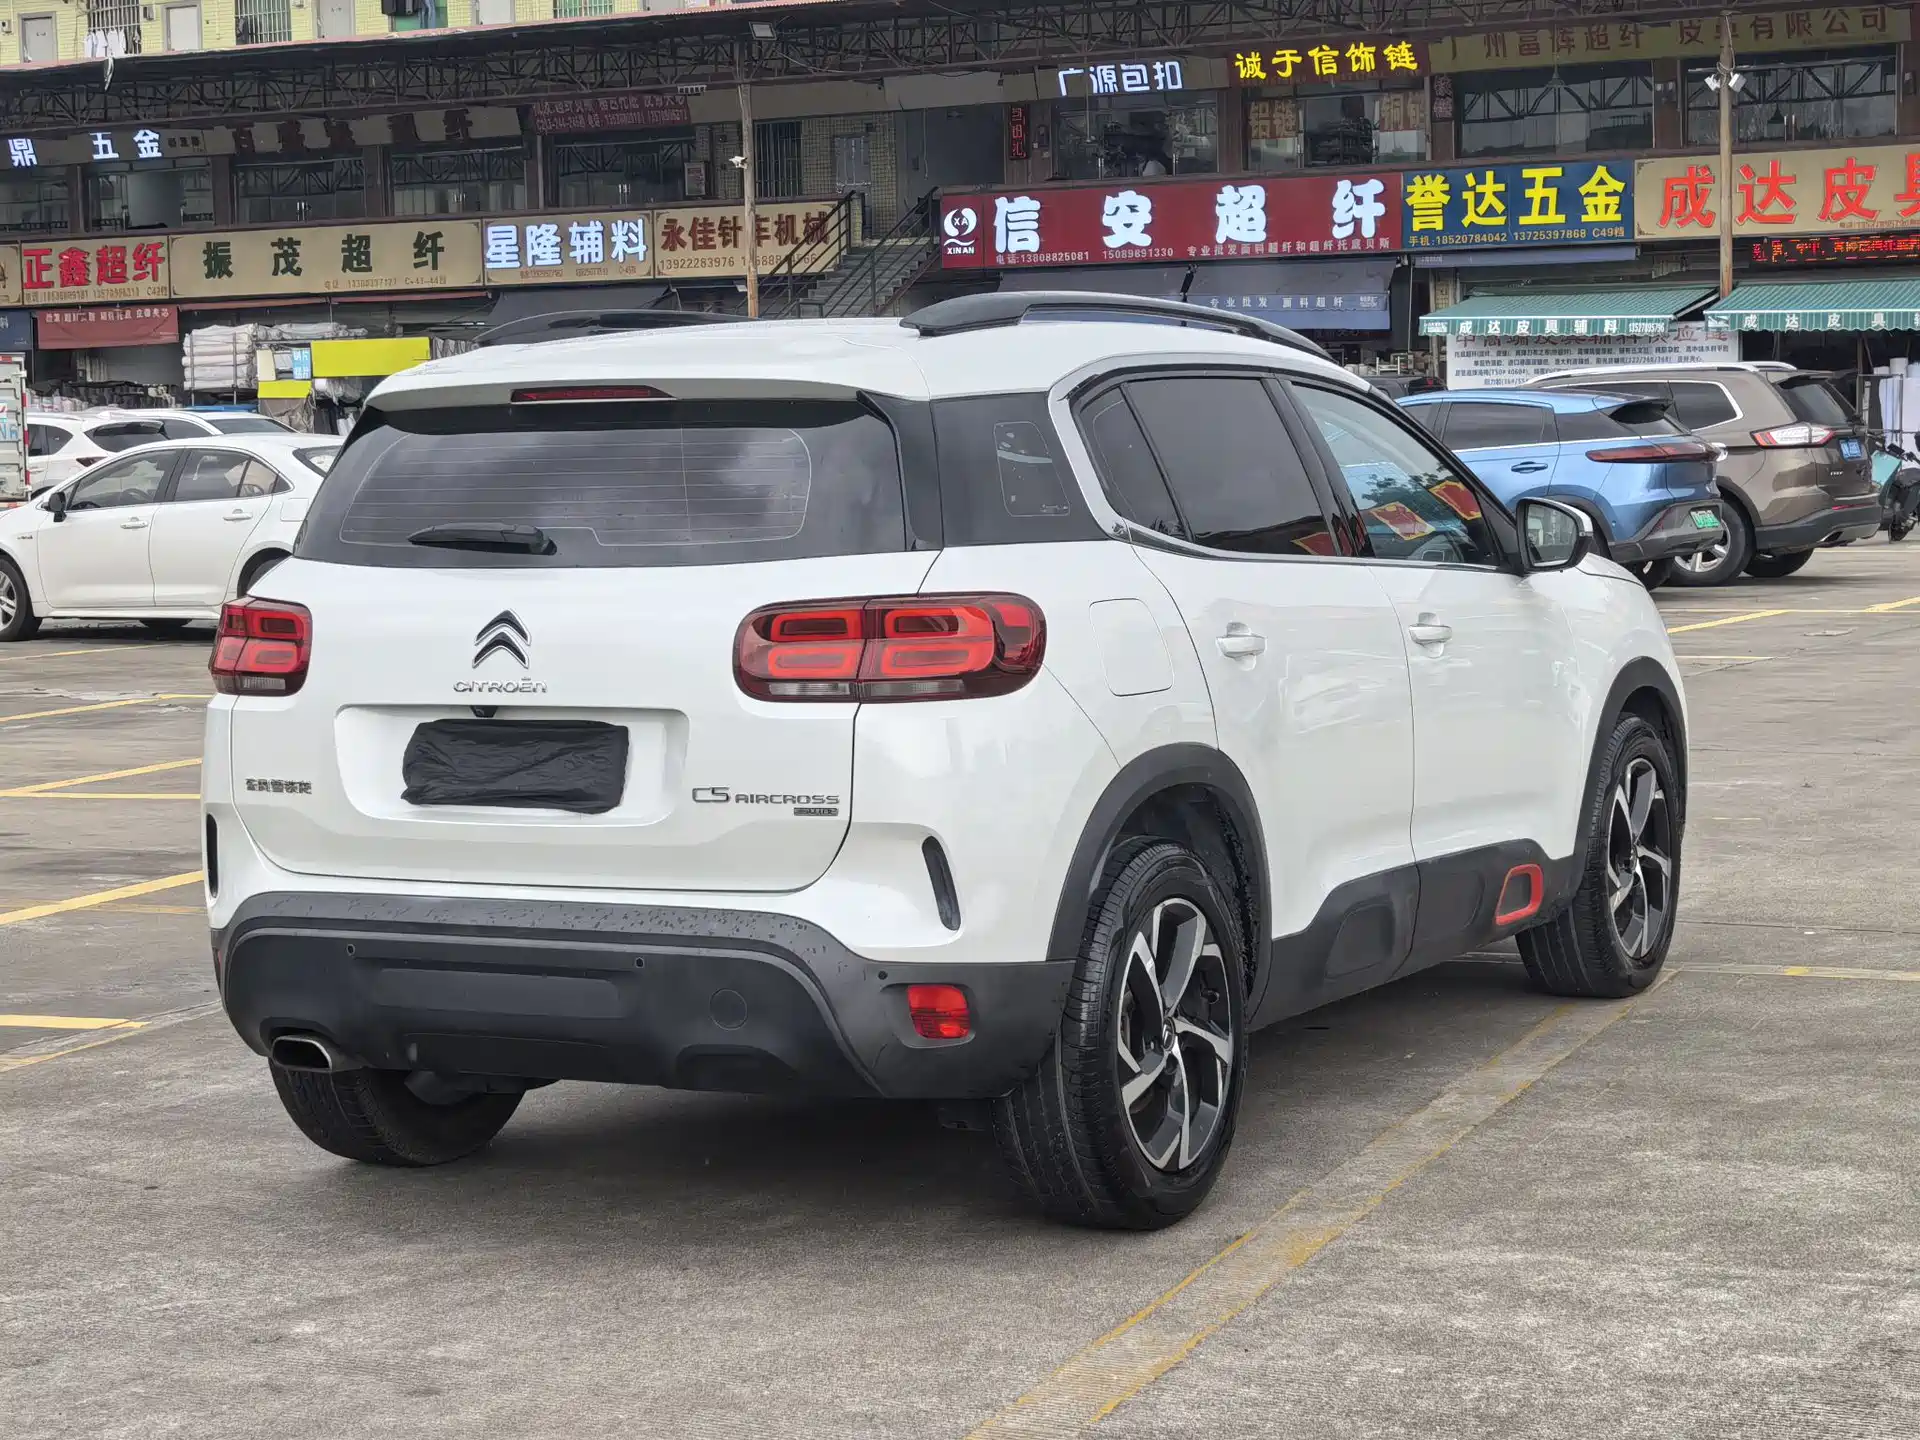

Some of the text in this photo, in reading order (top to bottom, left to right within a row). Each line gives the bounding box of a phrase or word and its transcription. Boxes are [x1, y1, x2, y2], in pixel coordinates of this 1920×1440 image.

[1234, 40, 1419, 80] 诚于信饰链
[1058, 61, 1183, 97] 广源包扣
[89, 129, 163, 160] 五金
[994, 178, 1386, 254] 信安超纤
[1405, 164, 1625, 232] 誉达五金
[203, 230, 445, 279] 振茂超纤
[485, 218, 648, 269] 星隆辅料
[22, 241, 166, 290] 正鑫超纤
[660, 256, 735, 270] 13922283976
[1459, 318, 1620, 335] 成达皮具辅料
[1743, 312, 1920, 330] 成达皮具
[453, 676, 549, 694] CITROËN
[692, 786, 841, 805] C5 AIRCROSS
